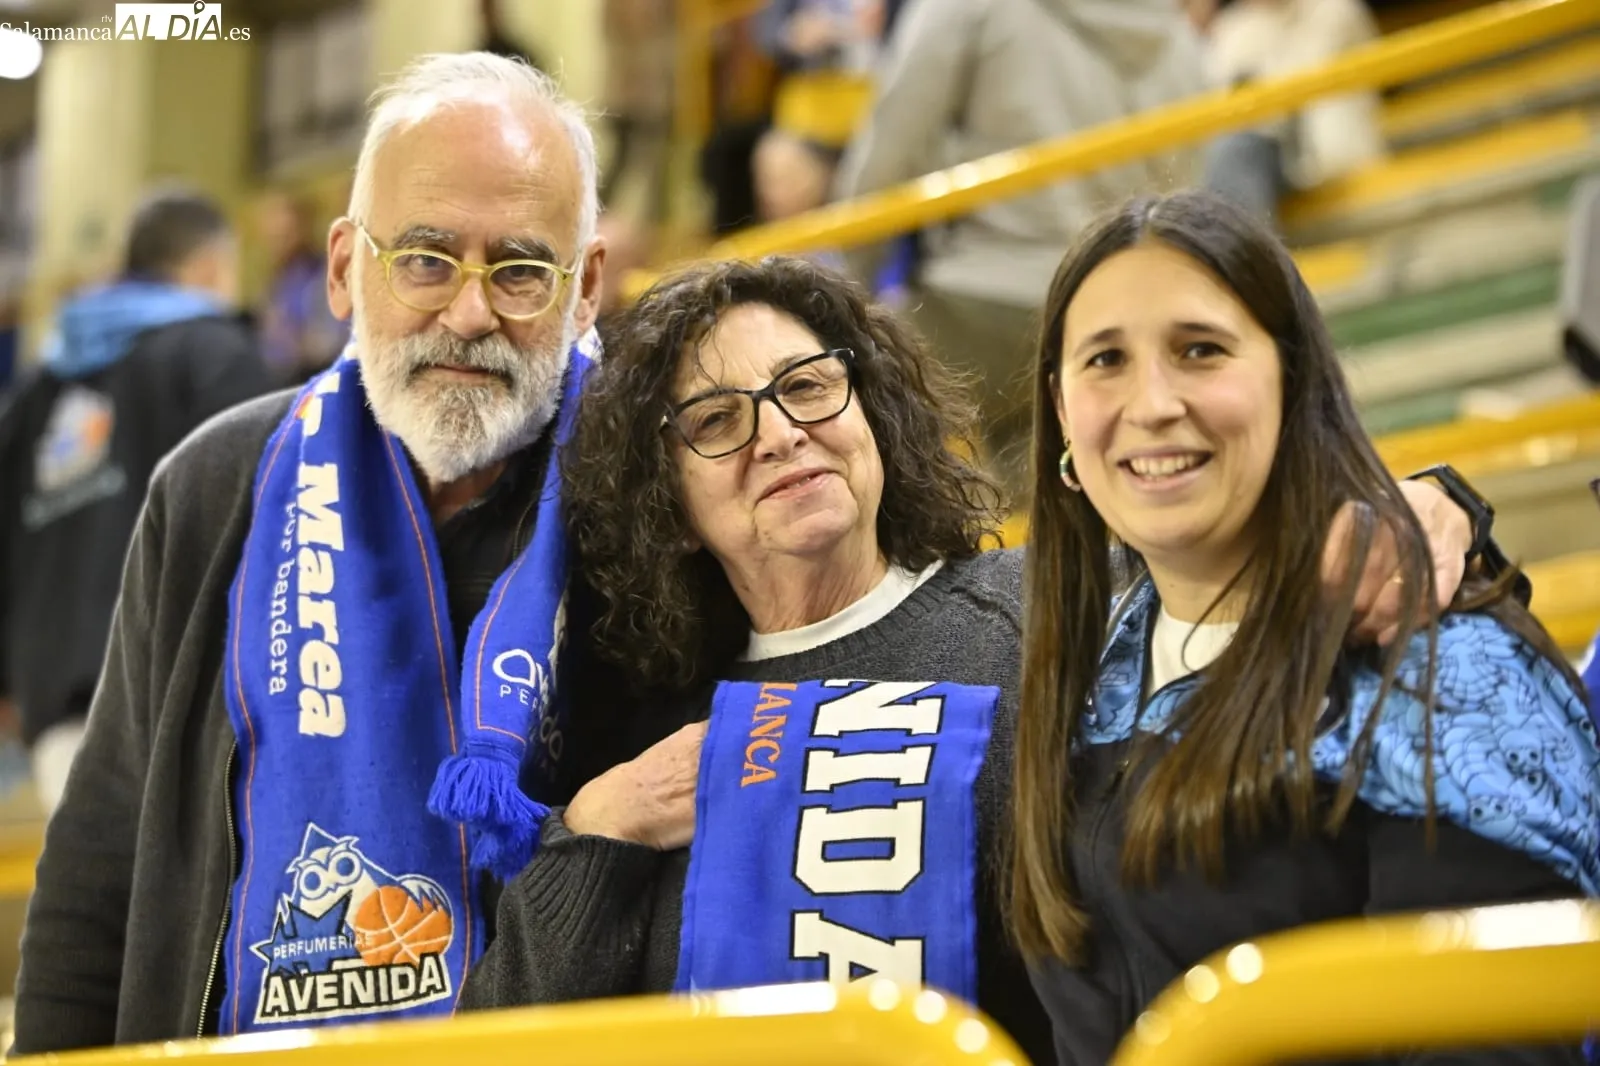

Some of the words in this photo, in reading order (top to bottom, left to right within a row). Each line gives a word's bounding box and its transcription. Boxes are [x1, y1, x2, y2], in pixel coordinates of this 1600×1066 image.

[268, 558, 295, 696] bandera
[297, 462, 346, 738] Marea
[261, 953, 446, 1016] AVENIDA
